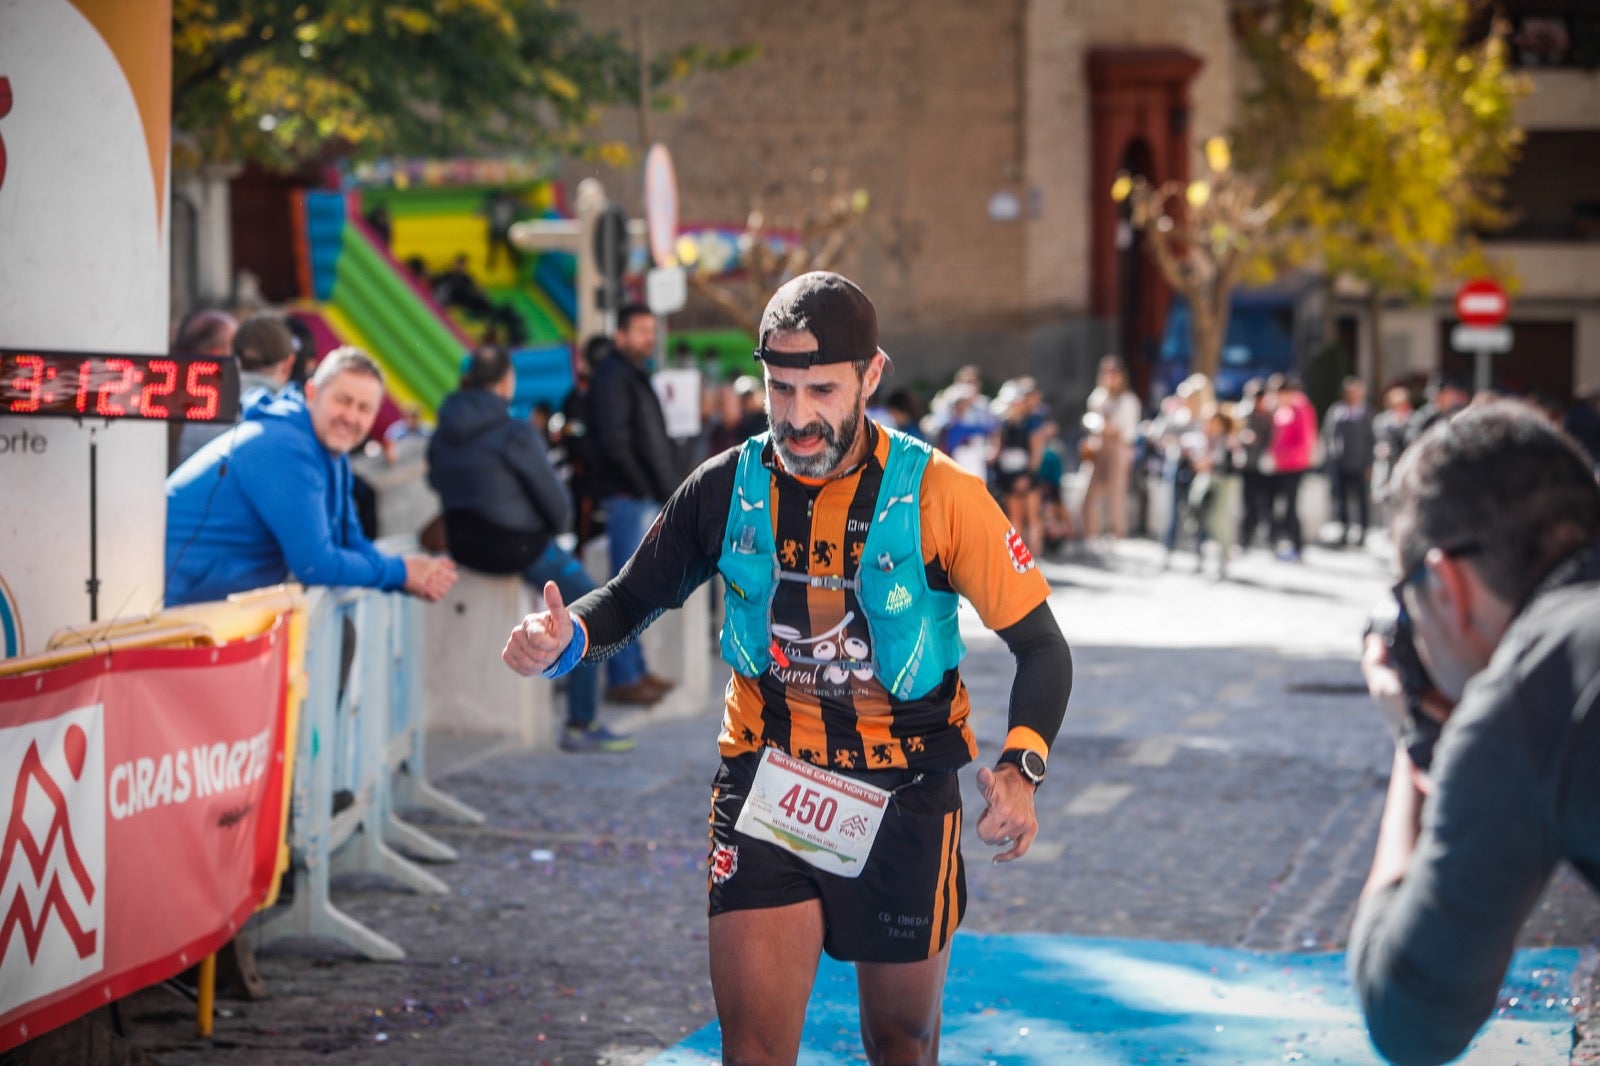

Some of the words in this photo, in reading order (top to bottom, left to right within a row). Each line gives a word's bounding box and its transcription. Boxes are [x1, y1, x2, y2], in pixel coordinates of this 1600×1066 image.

[769, 661, 820, 685] Rural
[109, 751, 192, 820] CARAS
[813, 768, 843, 788] CARAS
[778, 783, 838, 833] 450
[887, 927, 916, 940] TRAIL
